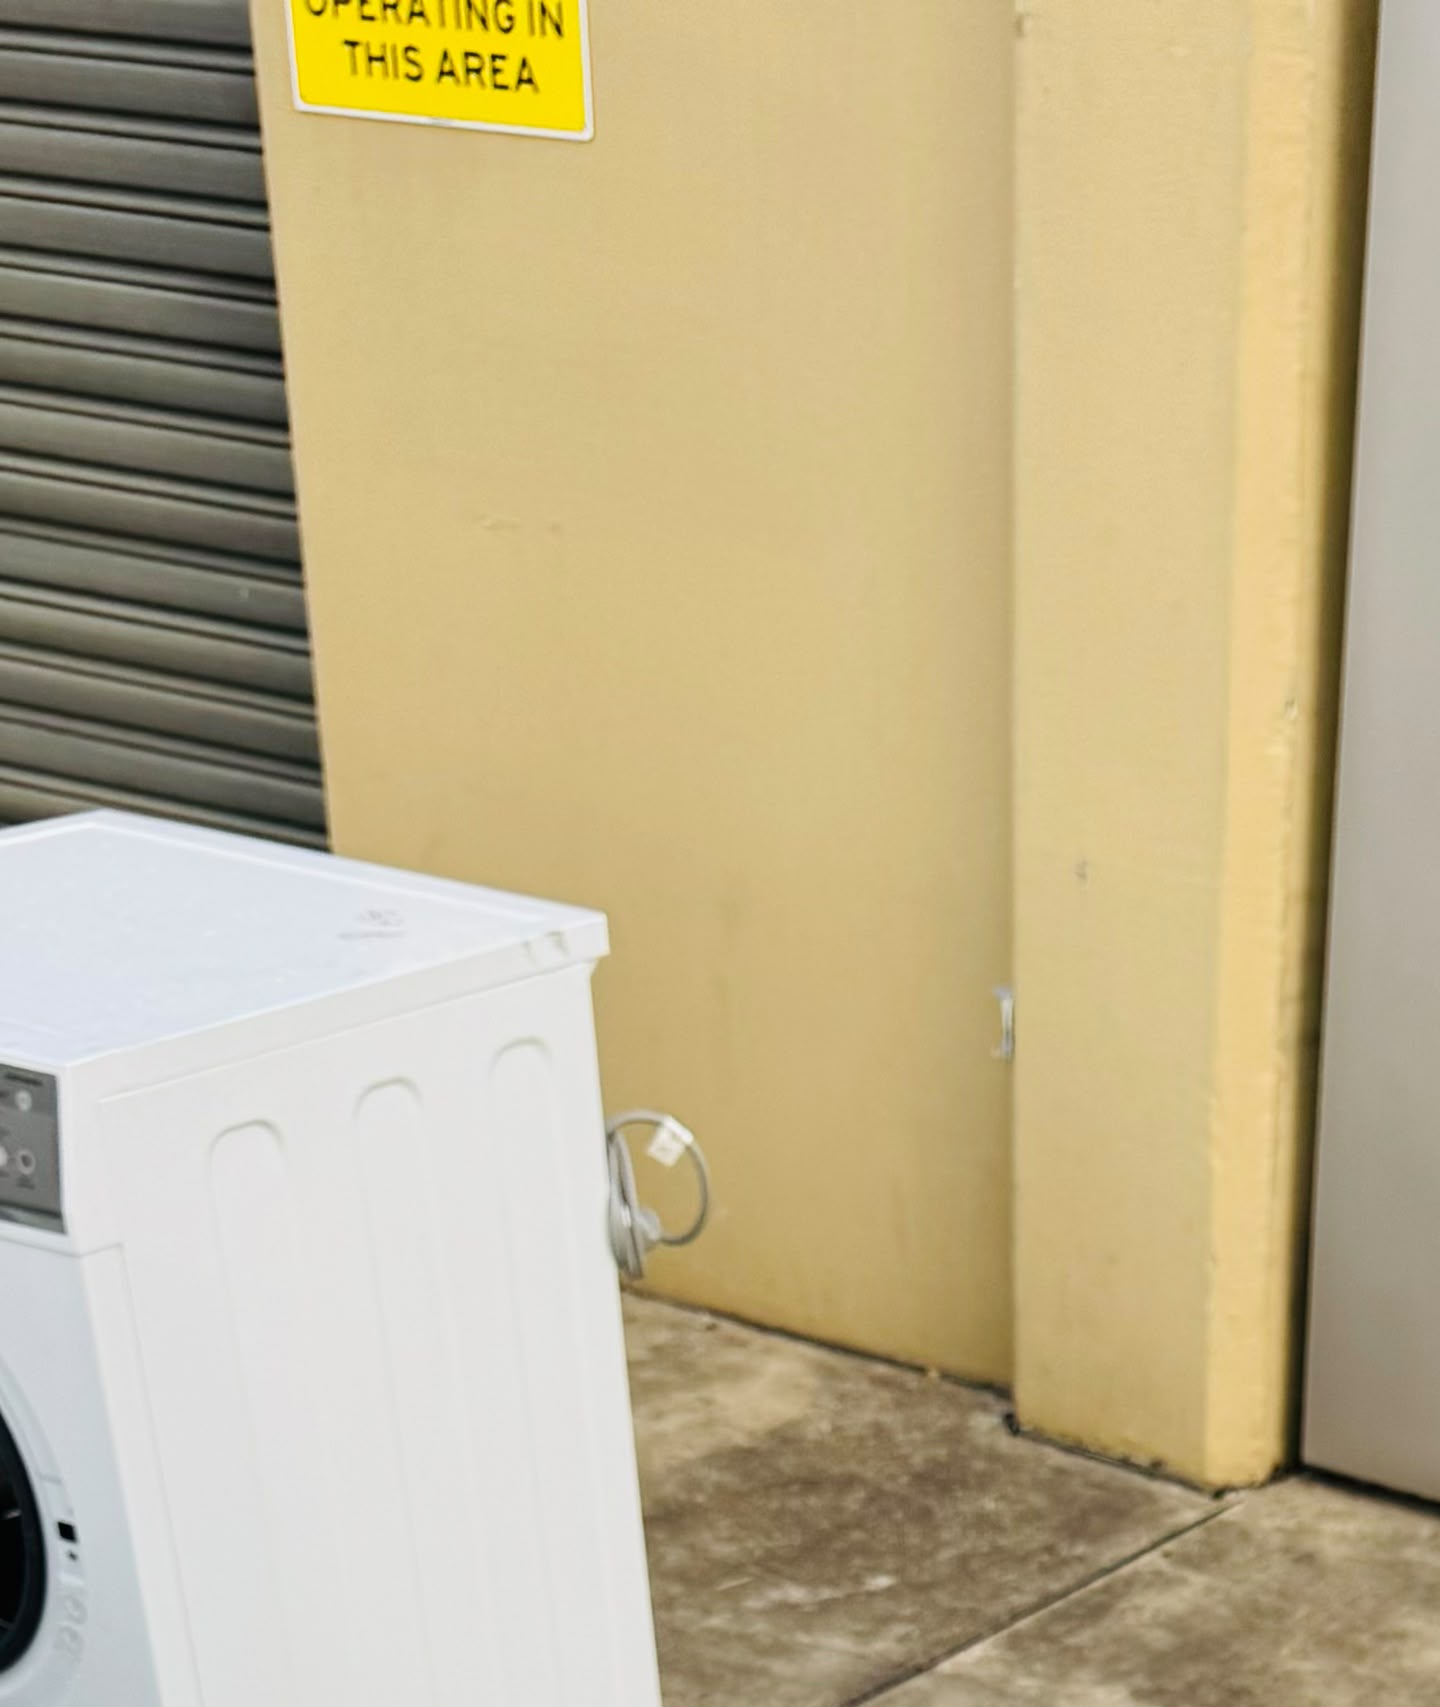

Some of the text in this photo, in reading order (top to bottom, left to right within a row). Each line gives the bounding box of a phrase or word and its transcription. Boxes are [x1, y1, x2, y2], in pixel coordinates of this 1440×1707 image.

[528, 0, 564, 37] IN
[343, 39, 540, 94] THIS AREA
